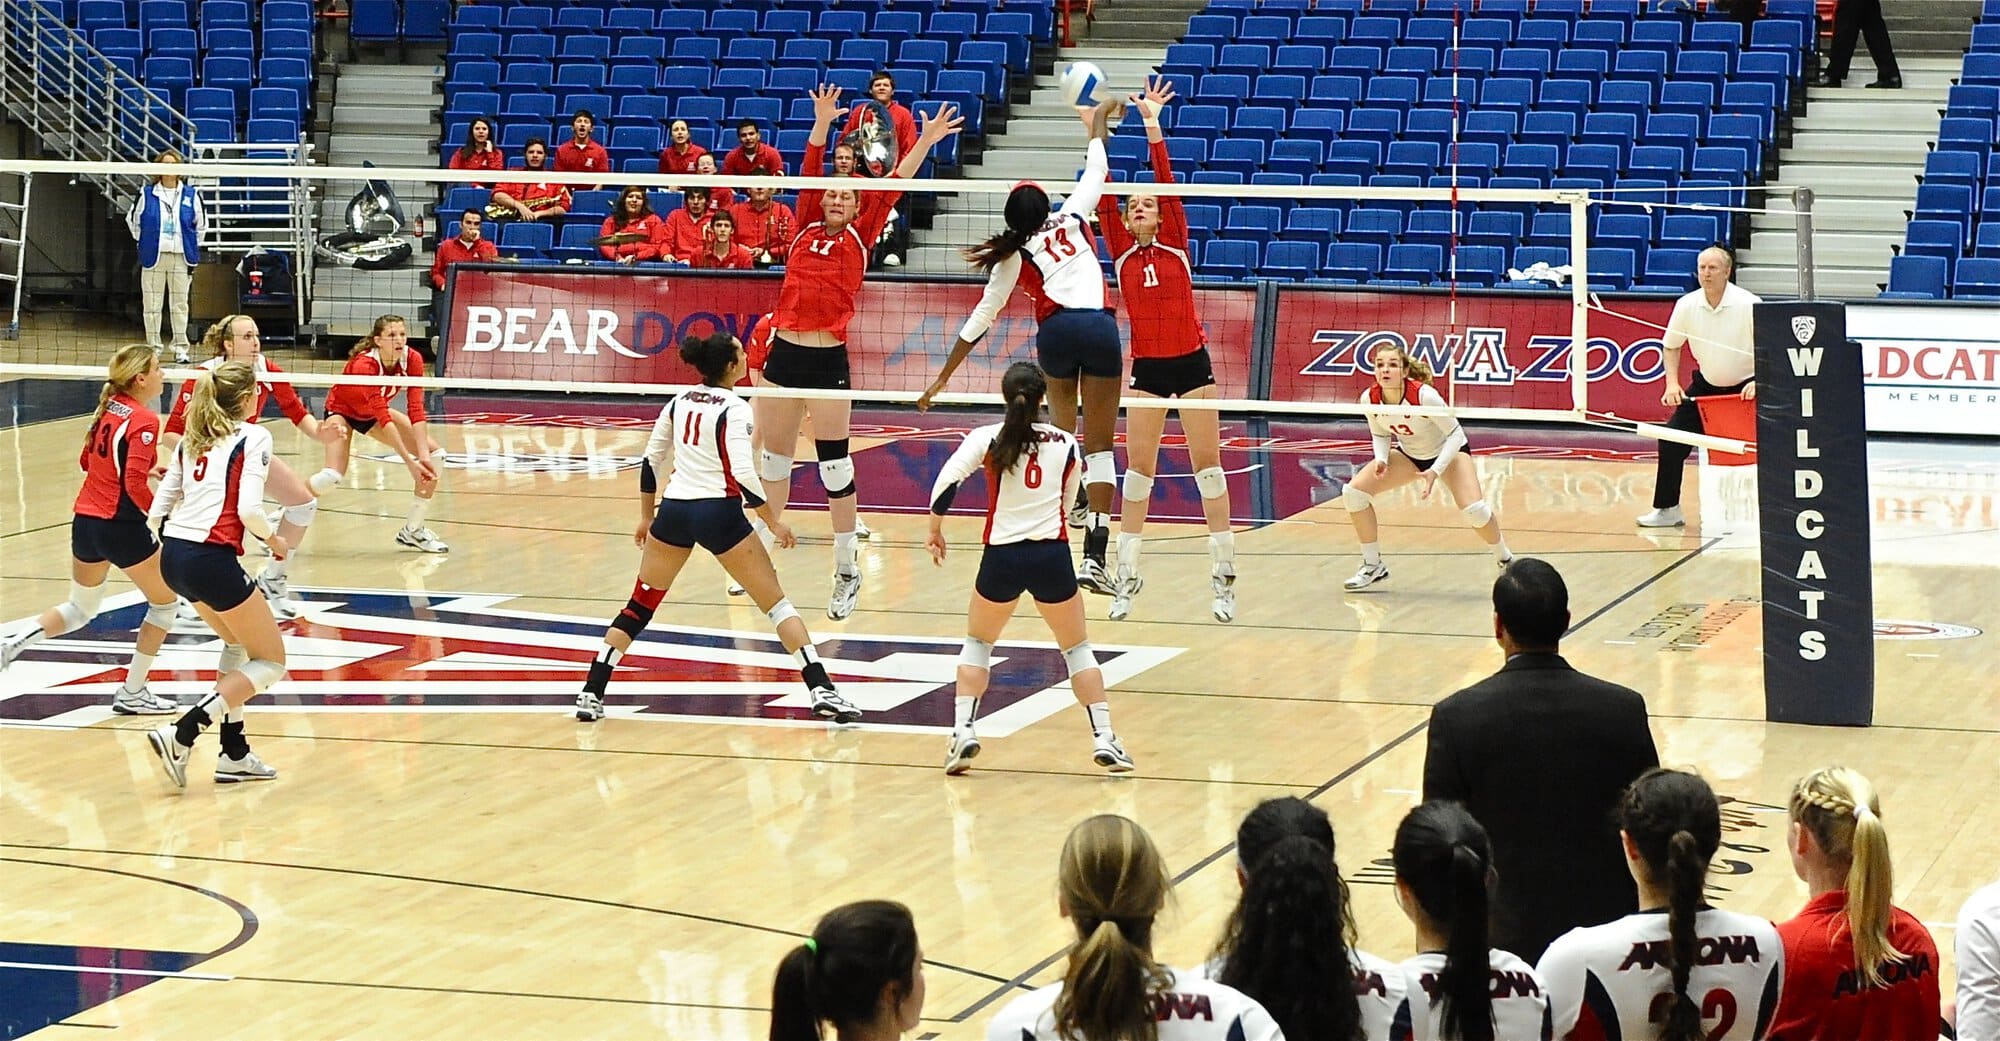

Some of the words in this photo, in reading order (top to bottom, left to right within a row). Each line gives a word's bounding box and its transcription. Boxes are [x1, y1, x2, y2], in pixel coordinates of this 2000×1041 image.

[809, 239, 835, 256] 17
[1044, 228, 1077, 264] 13
[1143, 263, 1159, 288] 11
[462, 305, 649, 359] BEAR
[1863, 346, 2000, 381] DCAT
[1888, 392, 1997, 403] MEMBER
[683, 411, 703, 446] 11
[1024, 452, 1042, 489] 6
[1786, 347, 1827, 661] WILDCATS
